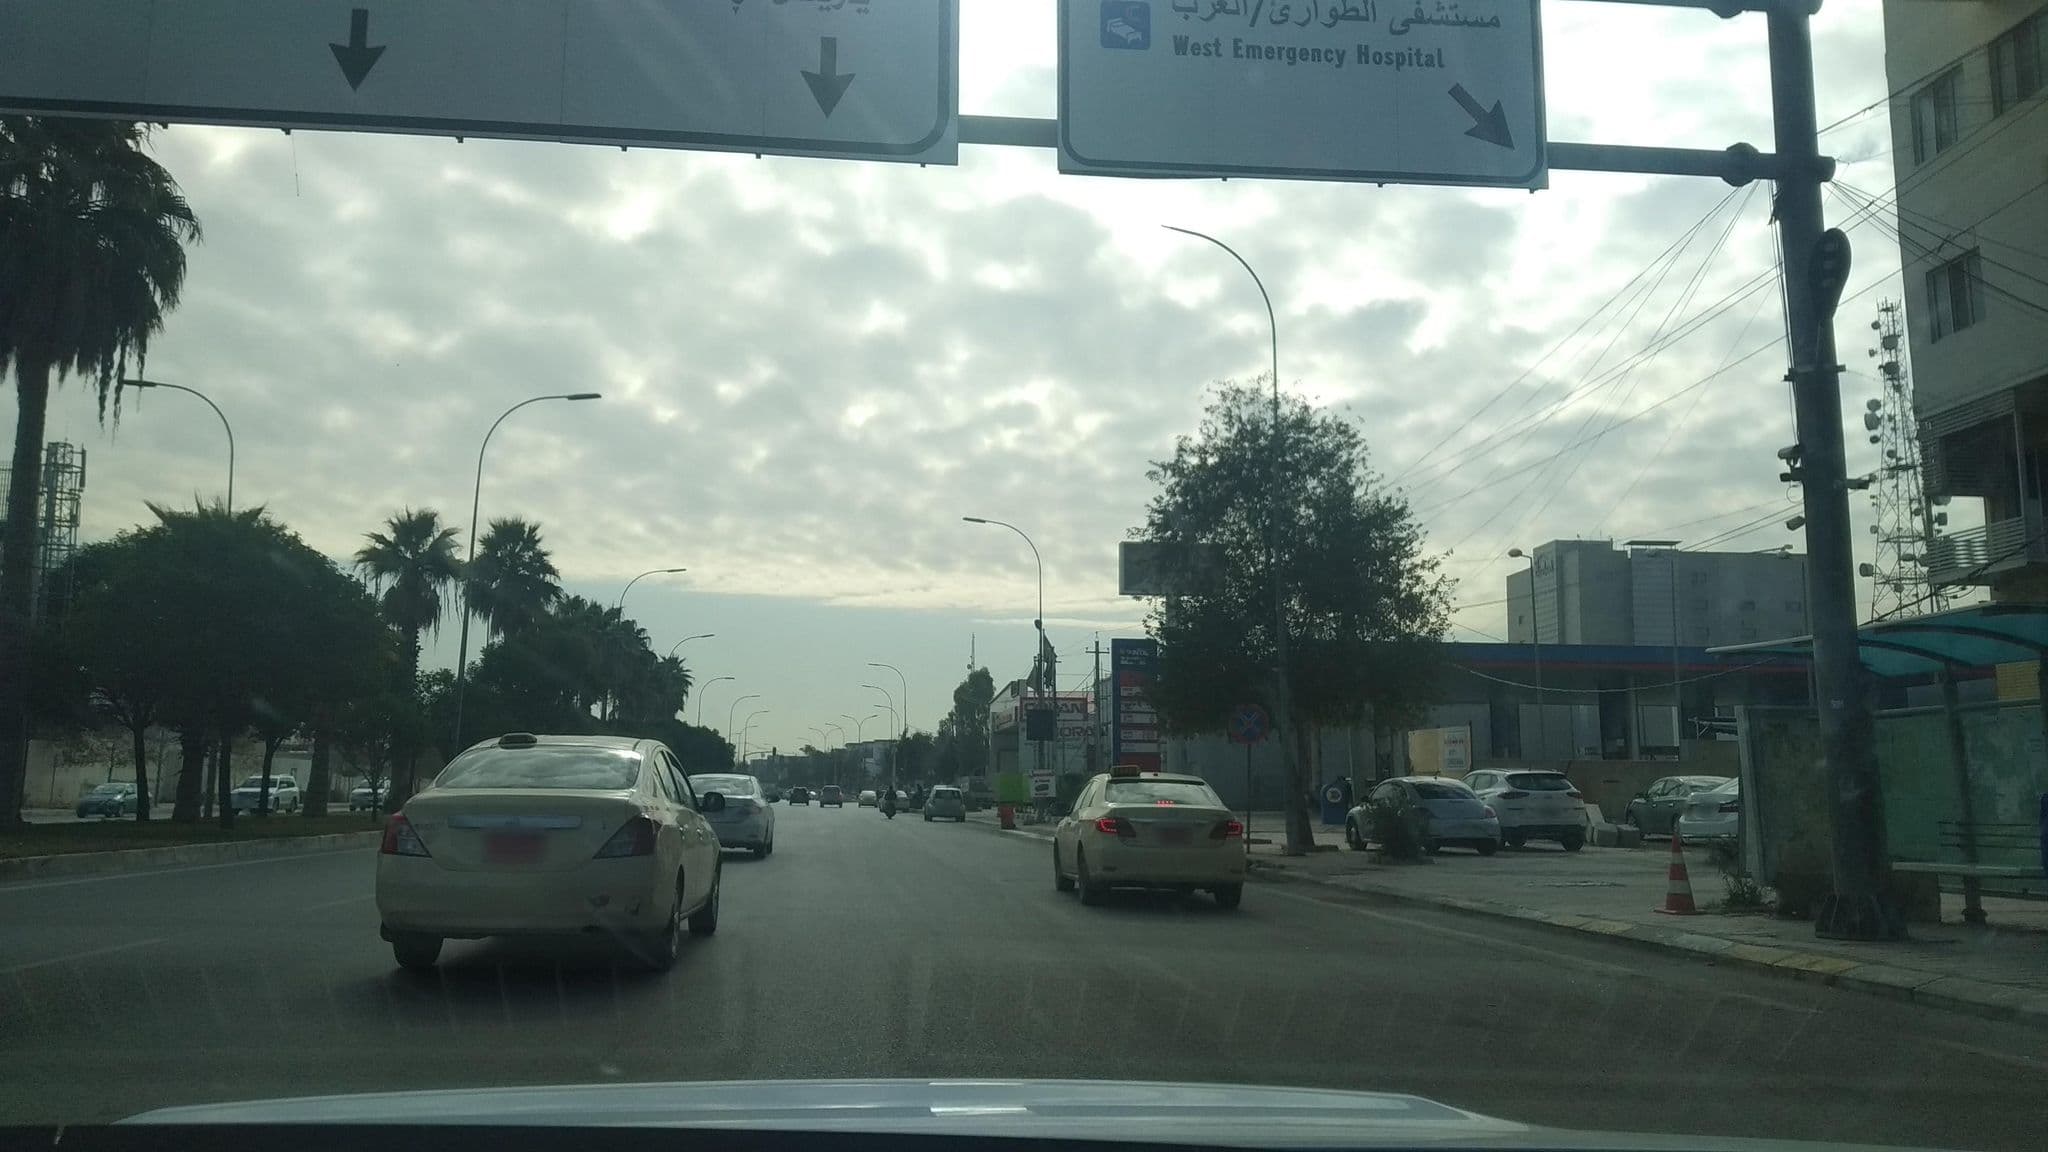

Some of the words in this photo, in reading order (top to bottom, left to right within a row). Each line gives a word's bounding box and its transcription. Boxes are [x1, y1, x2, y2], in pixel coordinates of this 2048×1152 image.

[1389, 0, 1501, 36] مستشفى
[1172, 34, 1224, 58] West
[1232, 37, 1346, 68] Emergency
[1356, 44, 1446, 72] Hospital
